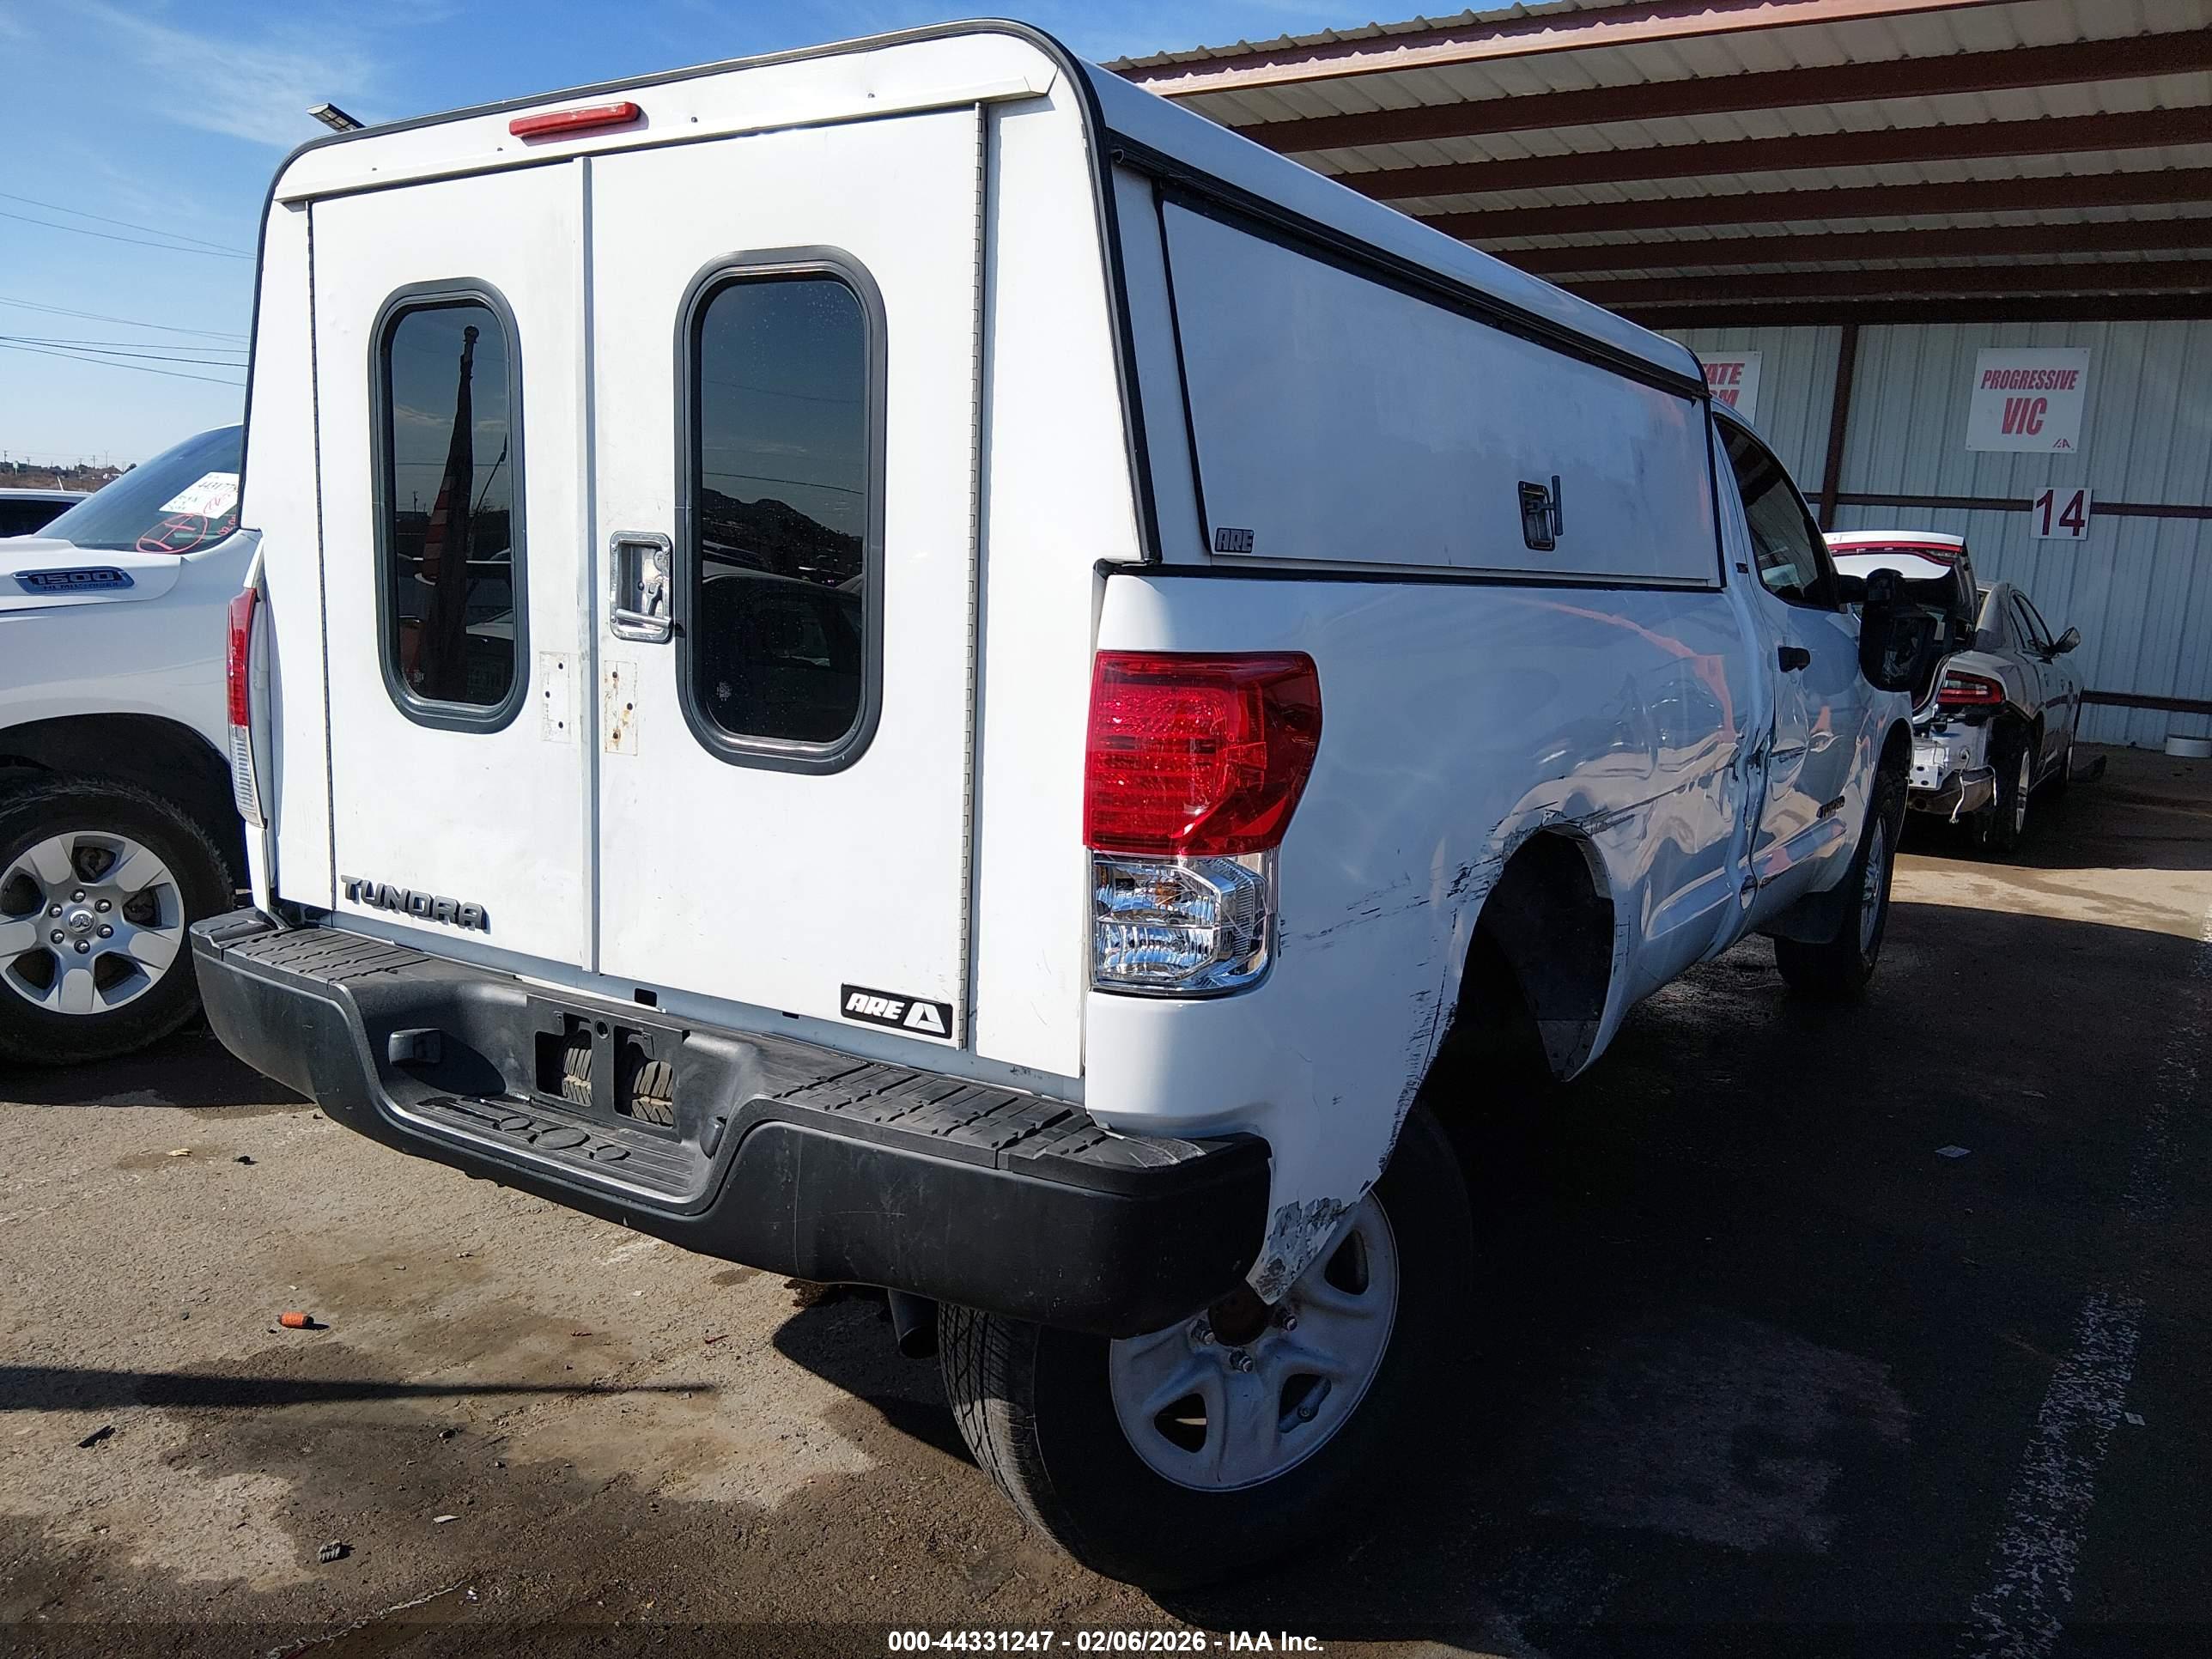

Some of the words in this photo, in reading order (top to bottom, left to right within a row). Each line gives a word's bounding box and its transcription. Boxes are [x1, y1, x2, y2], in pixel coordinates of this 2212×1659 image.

[1980, 369, 2080, 391] PROGRESSIVE
[2001, 397, 2048, 435] VIC
[2036, 489, 2085, 536] 14
[1216, 529, 1254, 551] ARE
[32, 571, 115, 585] 1500
[341, 875, 489, 930] TUNDRA
[845, 992, 906, 1020] ARE
